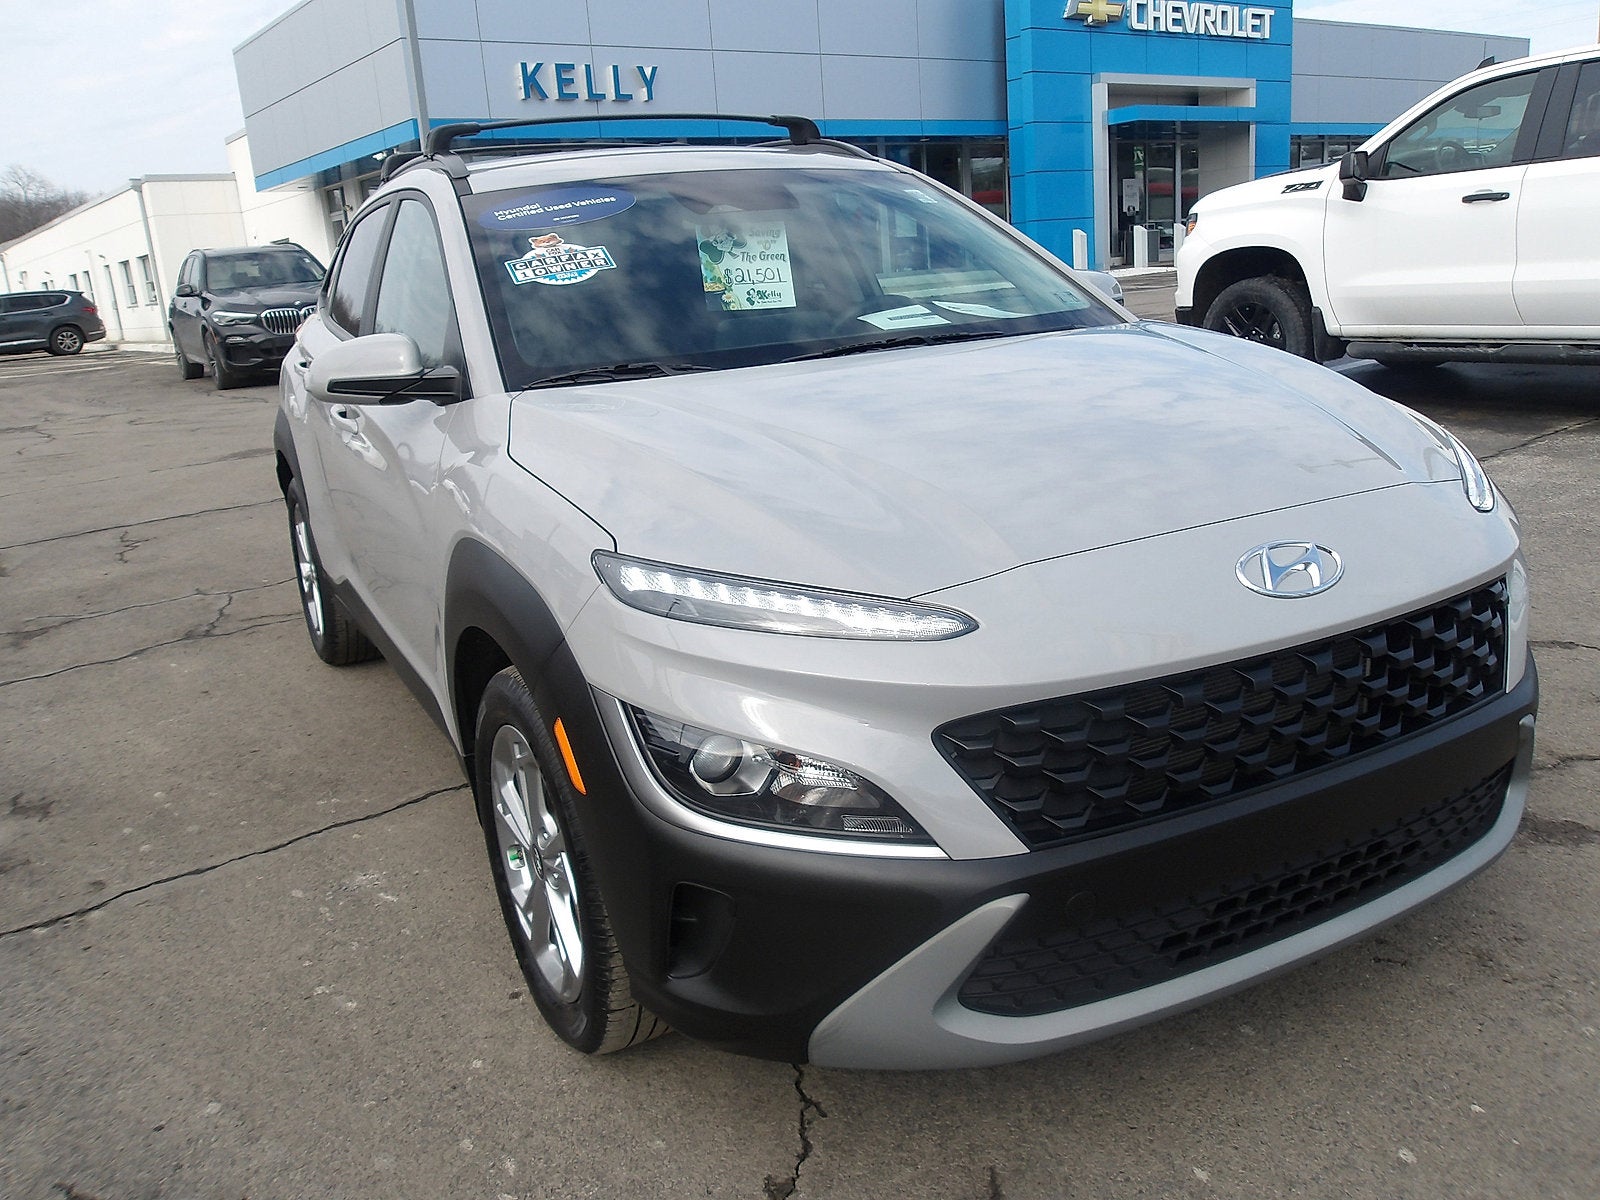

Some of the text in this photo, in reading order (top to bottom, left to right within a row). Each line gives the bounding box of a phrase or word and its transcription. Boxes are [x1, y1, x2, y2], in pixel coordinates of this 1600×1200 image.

[1129, 0, 1275, 39] CHEVROLET
[519, 61, 658, 101] KELLY
[494, 203, 541, 217] Hyundai
[497, 208, 544, 221] Certified
[544, 202, 572, 212] Used
[571, 196, 617, 207] Vehicles
[513, 251, 601, 271] CARFAX
[740, 250, 787, 263] The Green
[533, 258, 609, 277] OWNER
